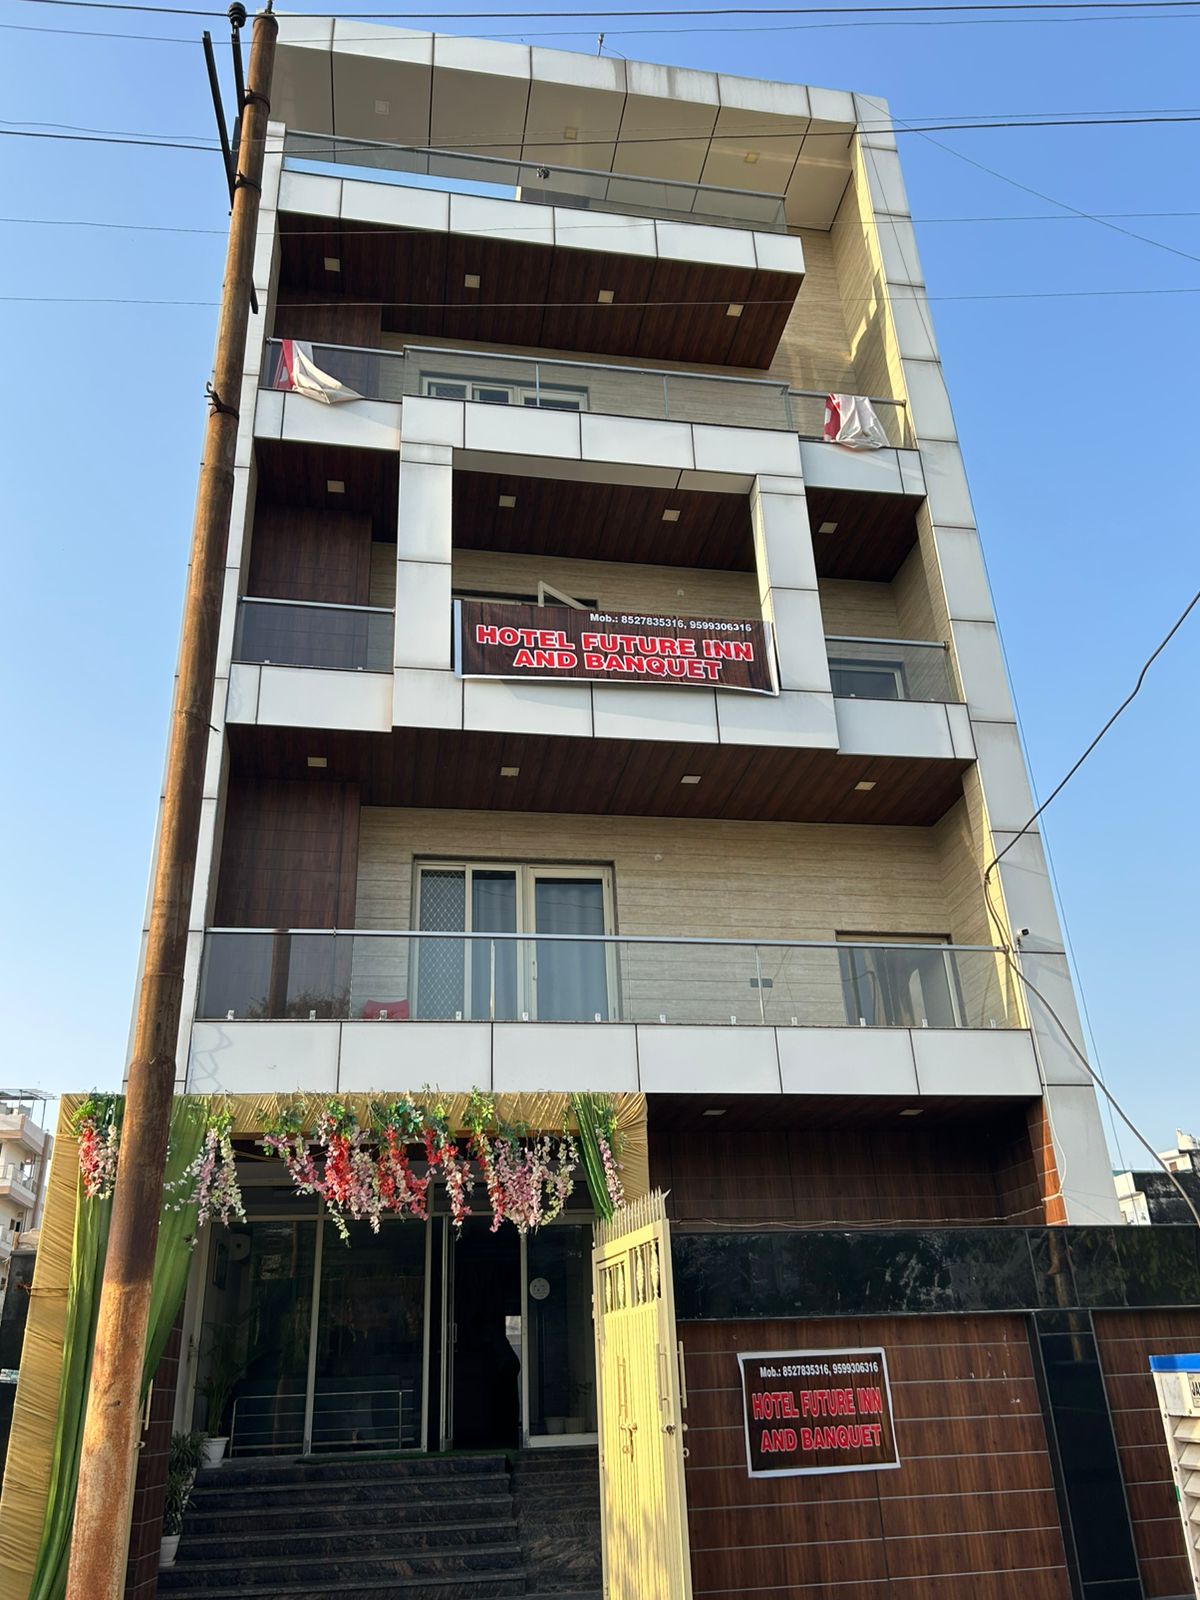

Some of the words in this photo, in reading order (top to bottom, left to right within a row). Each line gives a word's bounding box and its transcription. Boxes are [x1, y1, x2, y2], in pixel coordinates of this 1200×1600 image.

[589, 613, 619, 623] Mob.:
[620, 616, 688, 630] 8527835316,
[689, 620, 752, 632] 9599306316
[475, 624, 575, 650] HOTEL
[581, 631, 696, 657] FUTURE
[703, 640, 754, 662] INN
[512, 648, 578, 669] AND
[584, 653, 722, 679] BANQUET
[759, 1366, 781, 1378] Mob.:
[782, 1364, 832, 1377] 8527835316,
[832, 1361, 879, 1375] 9599306316
[752, 1391, 799, 1420] HOTEL
[800, 1388, 856, 1417] FUTURE
[857, 1387, 883, 1415] INN
[760, 1428, 797, 1452] AND
[800, 1423, 881, 1450] BANQUET
